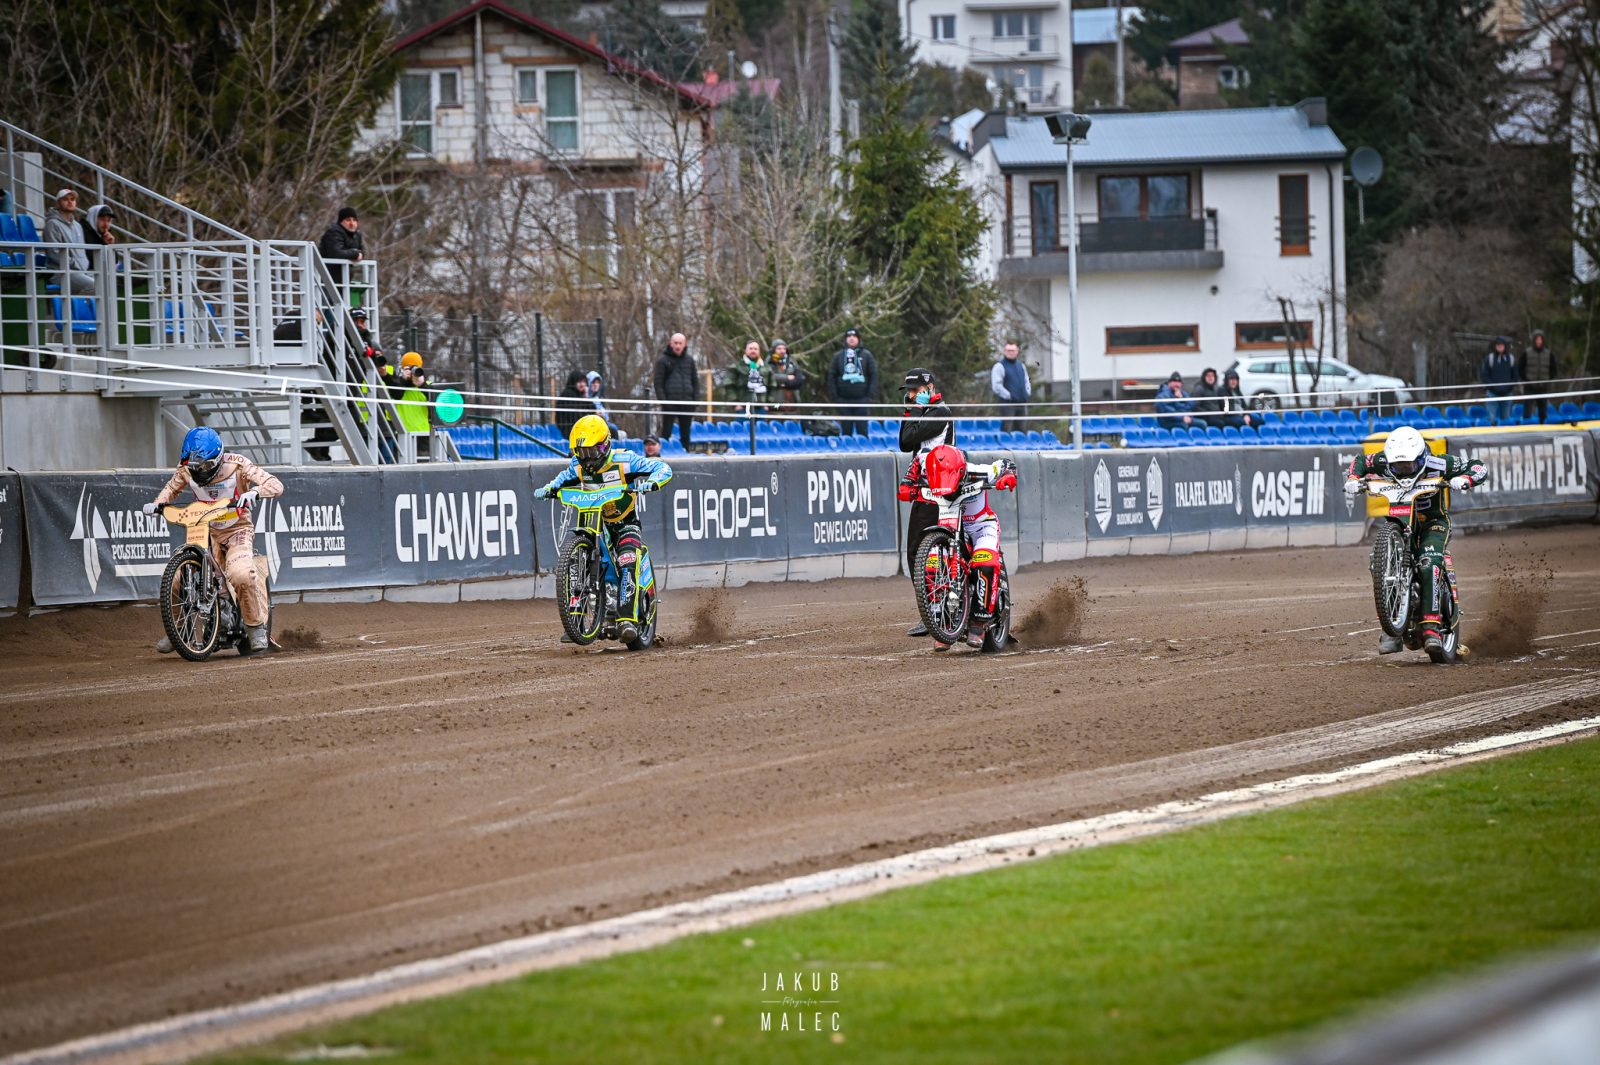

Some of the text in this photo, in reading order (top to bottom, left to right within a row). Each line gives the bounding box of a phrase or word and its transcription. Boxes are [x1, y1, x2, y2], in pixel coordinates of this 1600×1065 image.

[807, 468, 872, 515] PP DOM
[1174, 479, 1234, 508] FALAFEL KEBAB
[1252, 469, 1304, 518] CASE
[109, 511, 171, 538] MARMA
[290, 504, 345, 531] MARMA
[395, 489, 520, 563] CHAWER
[673, 487, 777, 541] EUROPEL
[291, 536, 345, 553] POLSKIE FOLIE
[814, 519, 869, 544] DEWELOPER
[112, 541, 171, 559] POLSKIE FOLIE
